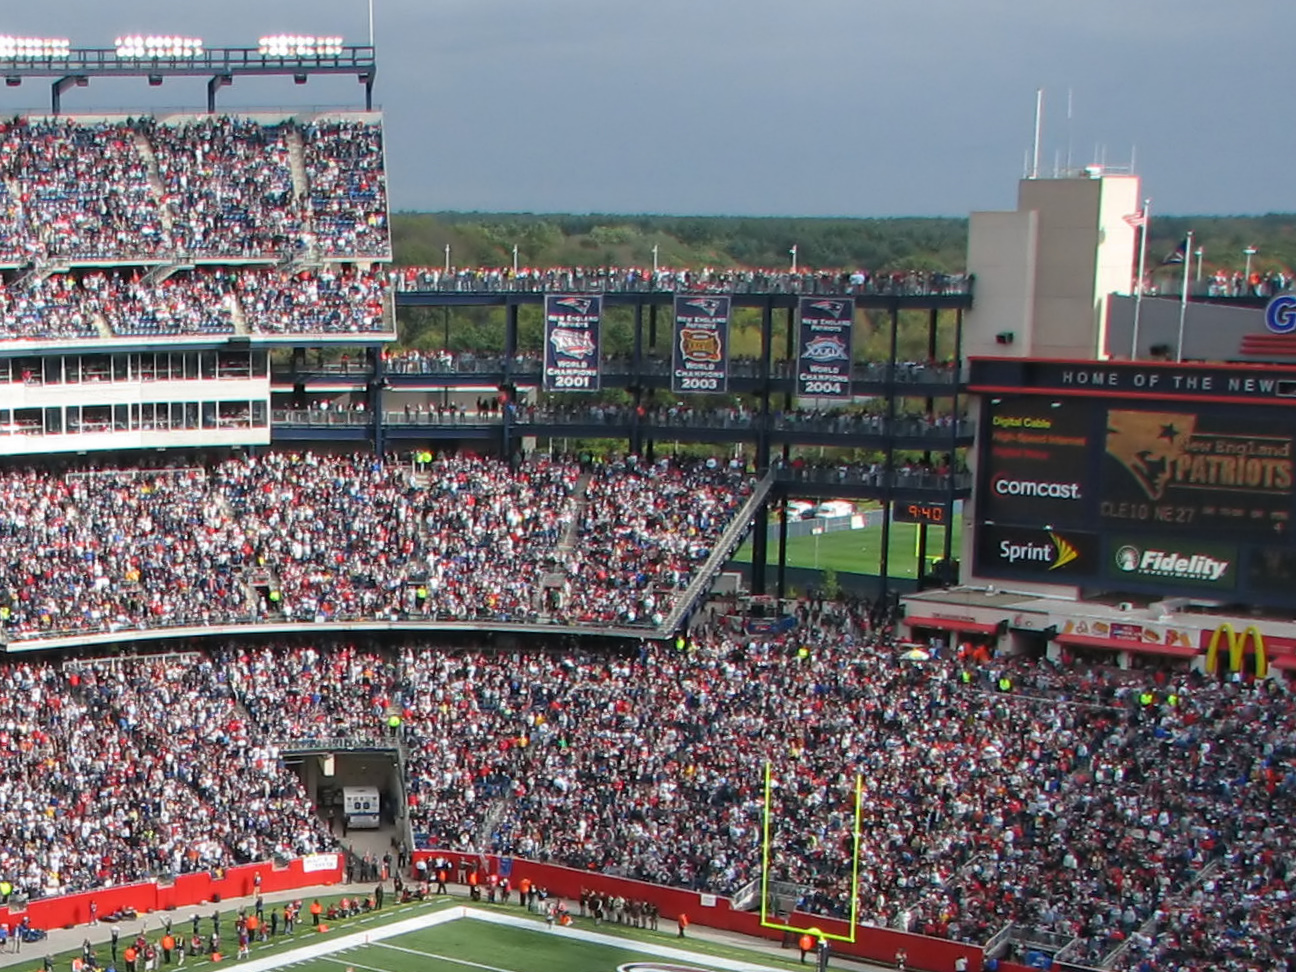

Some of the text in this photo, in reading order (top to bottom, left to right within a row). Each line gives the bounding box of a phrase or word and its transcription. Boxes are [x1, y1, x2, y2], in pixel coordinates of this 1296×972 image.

[557, 361, 588, 369] WORLD
[685, 362, 715, 370] WORLD
[809, 365, 840, 373] WORLD
[547, 368, 597, 376] CHAMPIONS
[675, 370, 725, 378] CHAMPIONS
[800, 373, 849, 382] CHAMPIONS
[555, 376, 590, 387] 2001
[681, 378, 717, 389] 2003
[1063, 371, 1275, 393] HOME OF THE NEW
[805, 382, 842, 393] 2004
[1175, 454, 1292, 488] PATRIOTS
[996, 480, 1079, 499] comcast
[908, 505, 942, 520] 9:40
[1000, 540, 1052, 562] Sprint
[1139, 550, 1228, 580] Fidelity
